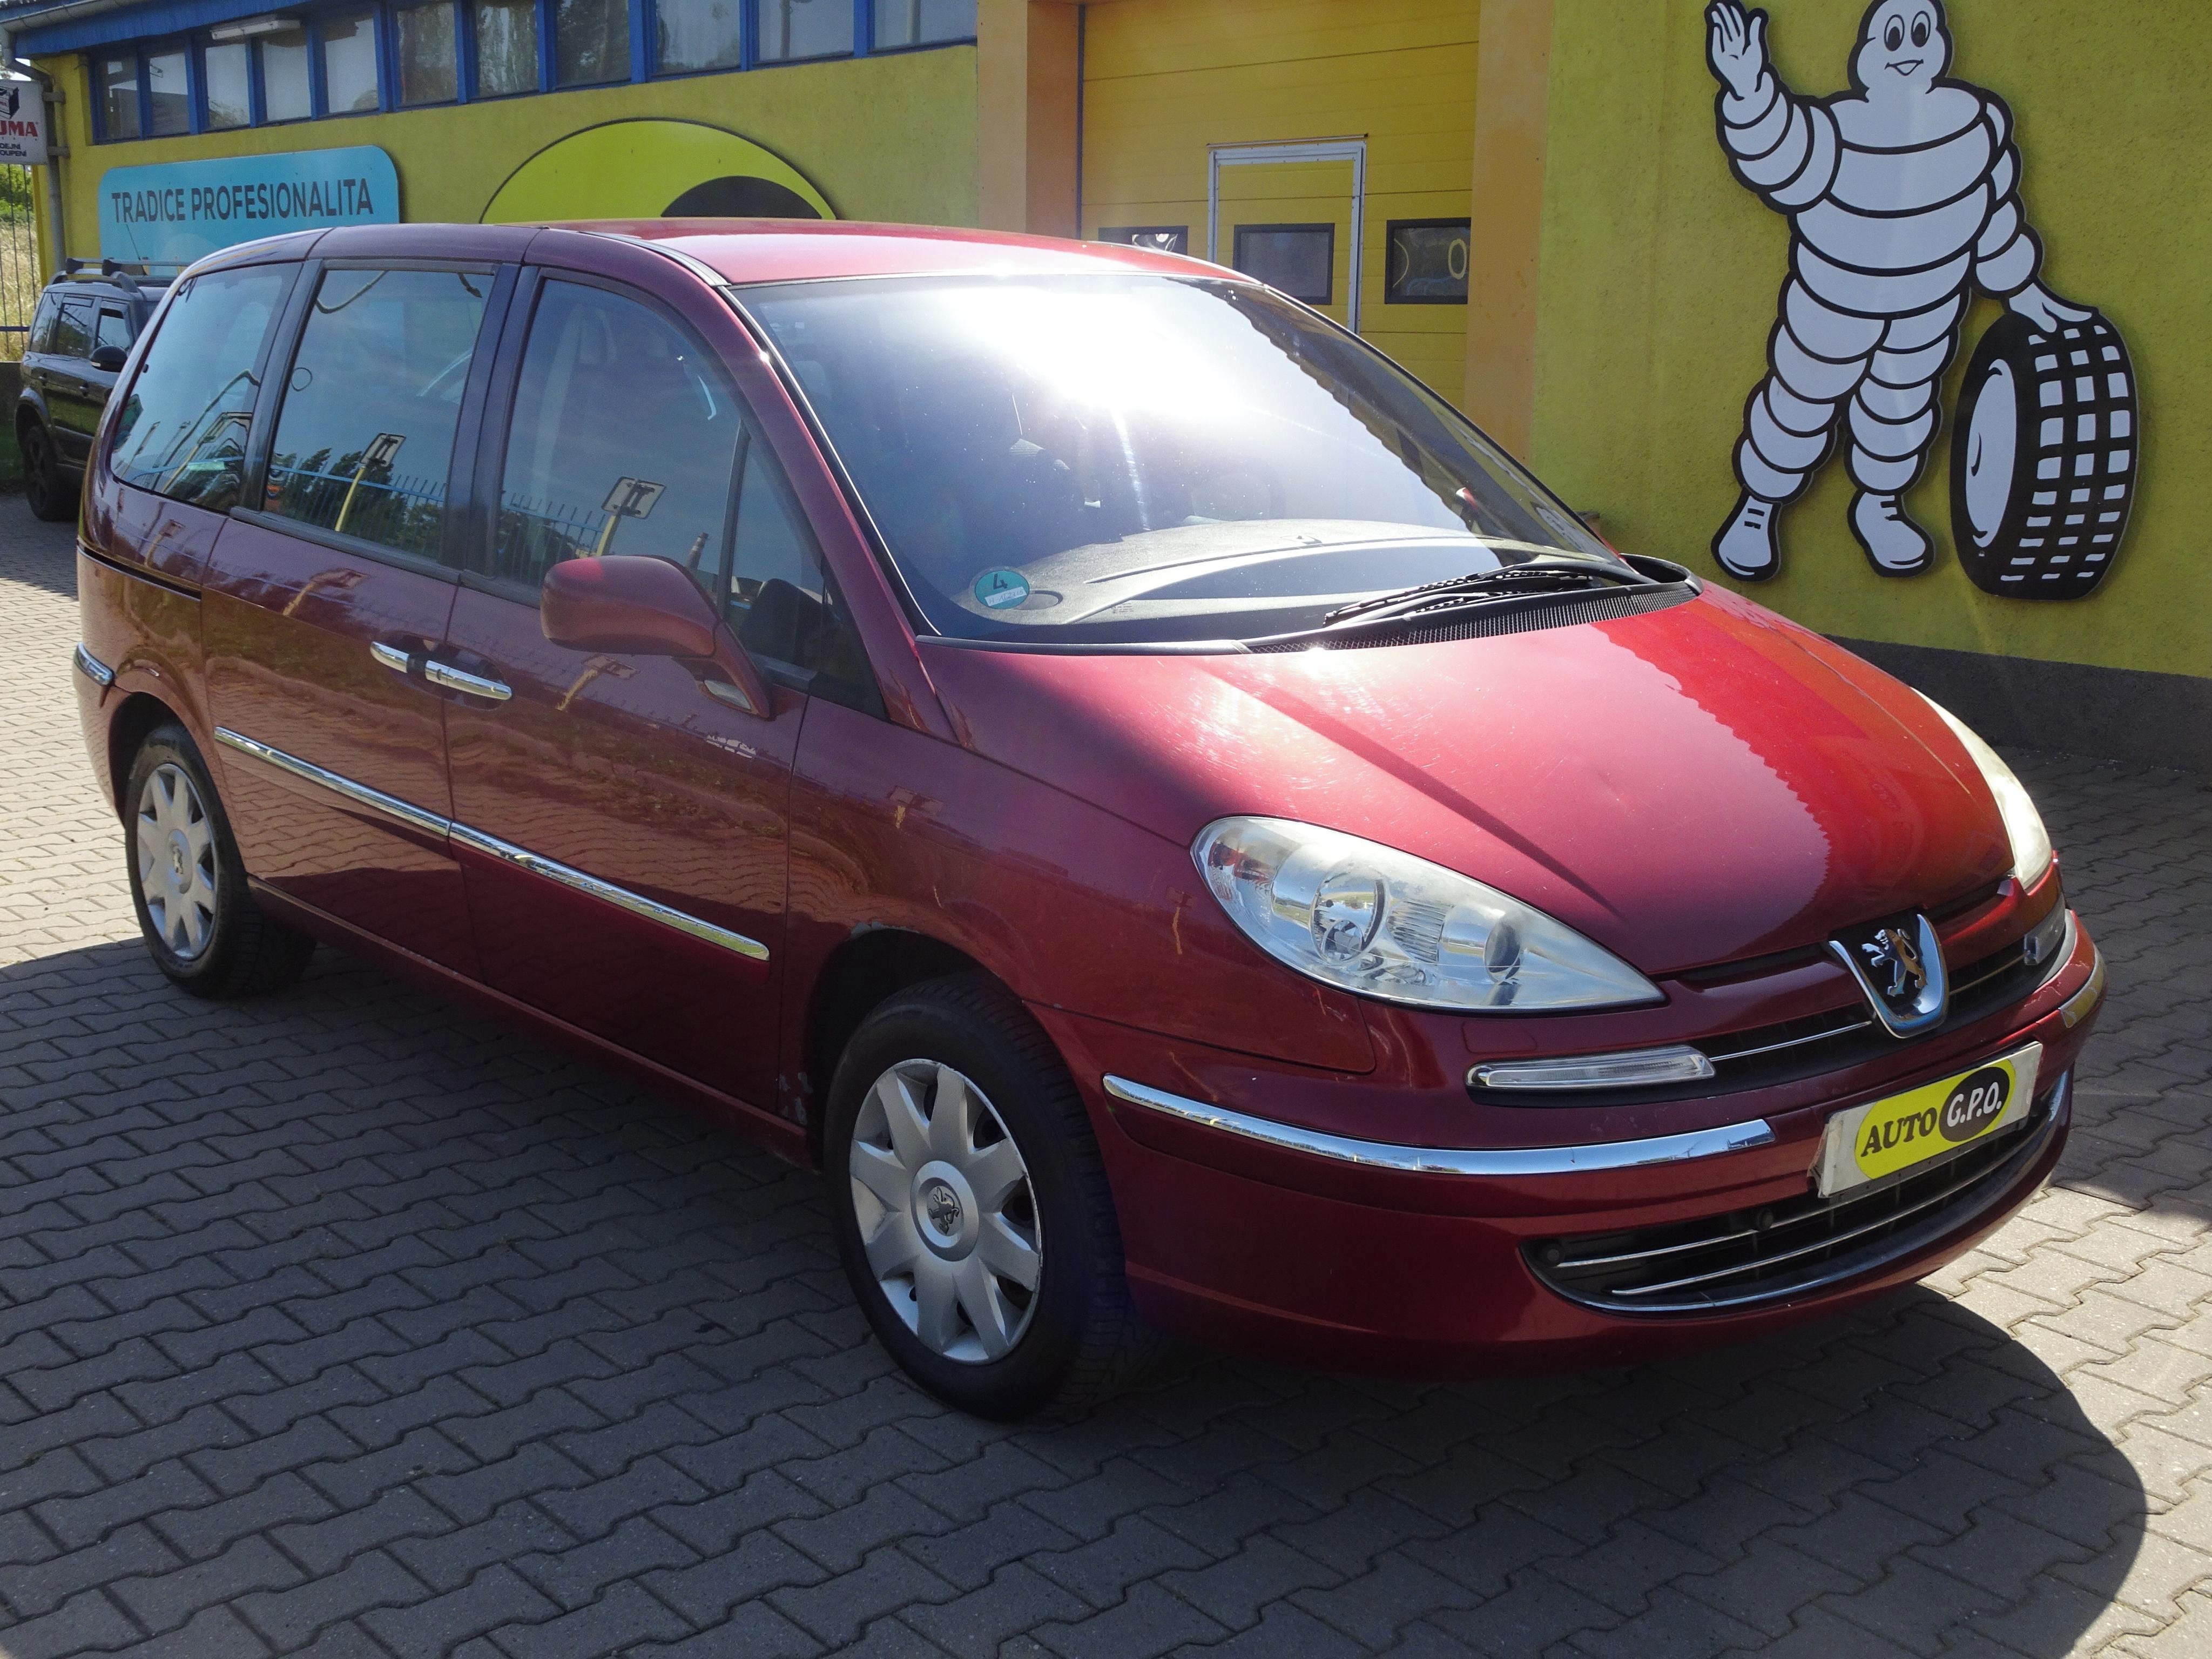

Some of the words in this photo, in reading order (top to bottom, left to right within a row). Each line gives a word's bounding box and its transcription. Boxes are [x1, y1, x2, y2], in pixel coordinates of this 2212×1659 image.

[111, 188, 186, 224] TRADICE
[191, 178, 374, 220] PROFESIONALITA
[993, 573, 1008, 589] 4
[1860, 1107, 1938, 1158] AUTO
[1946, 1081, 2002, 1128] G.P.O.
